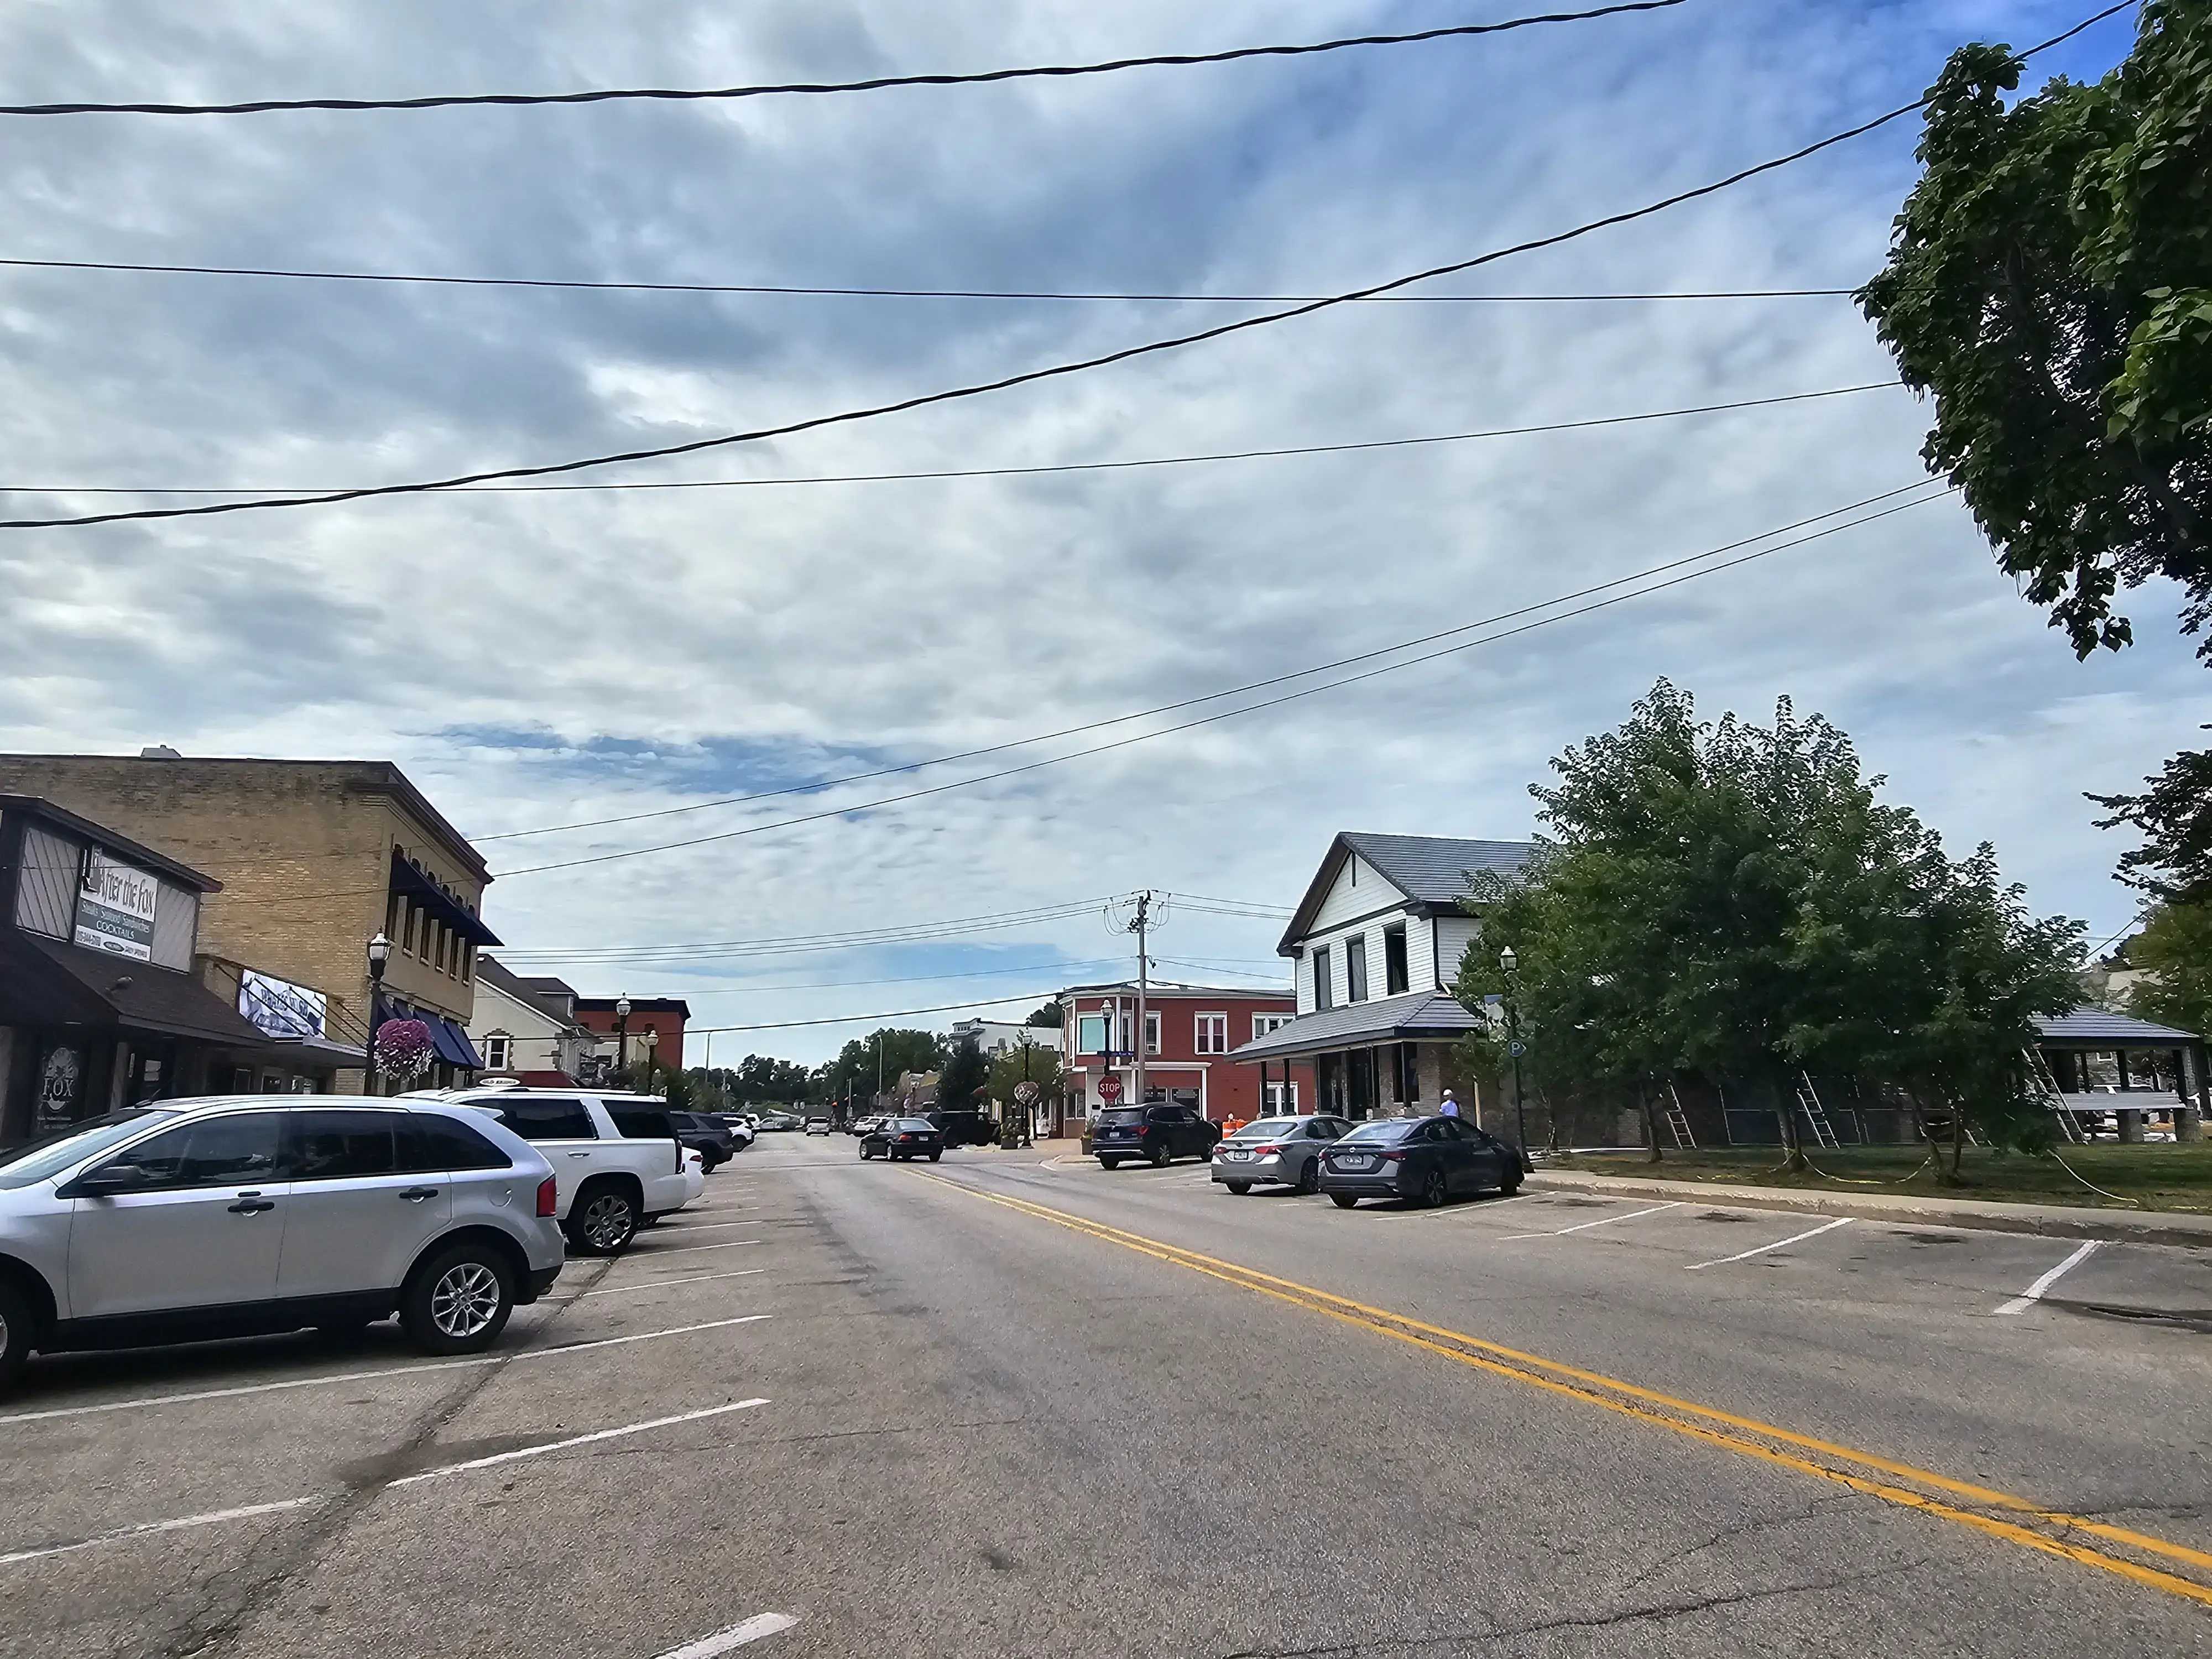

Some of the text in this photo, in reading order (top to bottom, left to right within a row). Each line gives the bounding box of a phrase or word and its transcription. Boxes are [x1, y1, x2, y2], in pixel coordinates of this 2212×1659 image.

[96, 920, 135, 940] COCKTAILS
[1511, 1042, 1520, 1053] P
[42, 1078, 74, 1097] FOX
[1099, 1083, 1120, 1093] STOP
